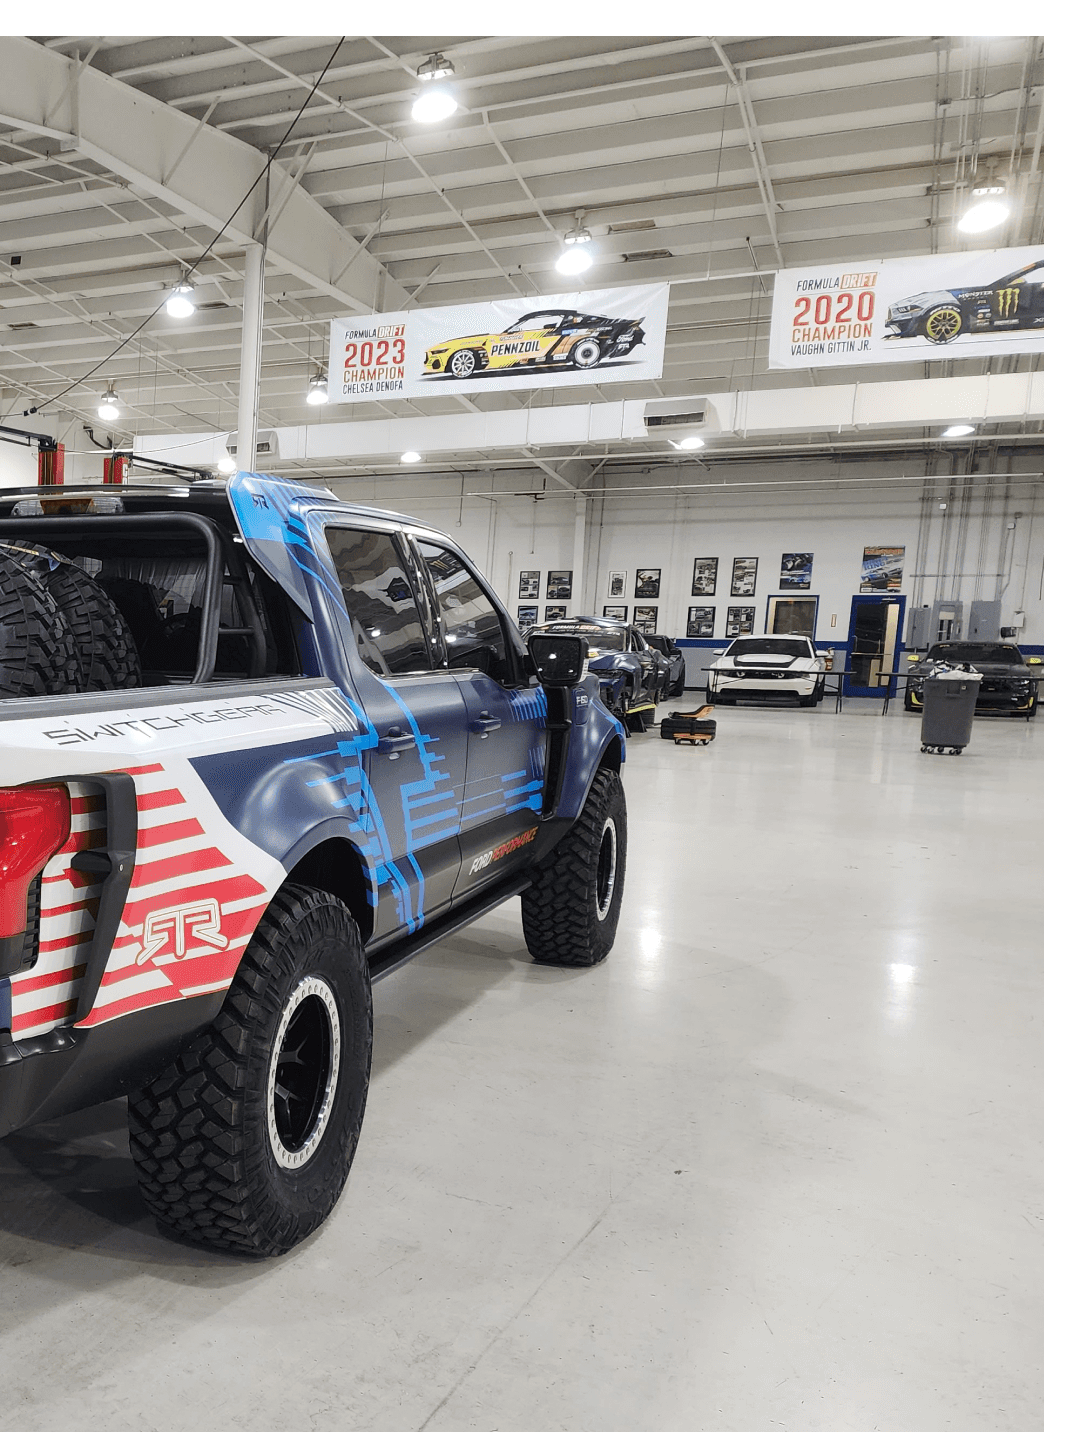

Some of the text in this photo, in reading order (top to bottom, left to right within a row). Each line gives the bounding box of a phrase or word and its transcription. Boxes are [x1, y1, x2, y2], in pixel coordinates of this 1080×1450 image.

[796, 272, 877, 291] FORMULA DRIFT
[793, 291, 875, 326] 2020
[345, 324, 406, 340] FORMULA DRIFT
[792, 323, 873, 343] CHAMPION
[344, 338, 406, 369] 2023
[491, 340, 541, 357] PENNZOIL
[791, 339, 872, 355] VAUGHN GITTIN JR.
[343, 366, 405, 383] CHAMPION
[343, 380, 404, 394] CHELSEA DENOFA
[42, 703, 287, 746] SWITCHGEAR
